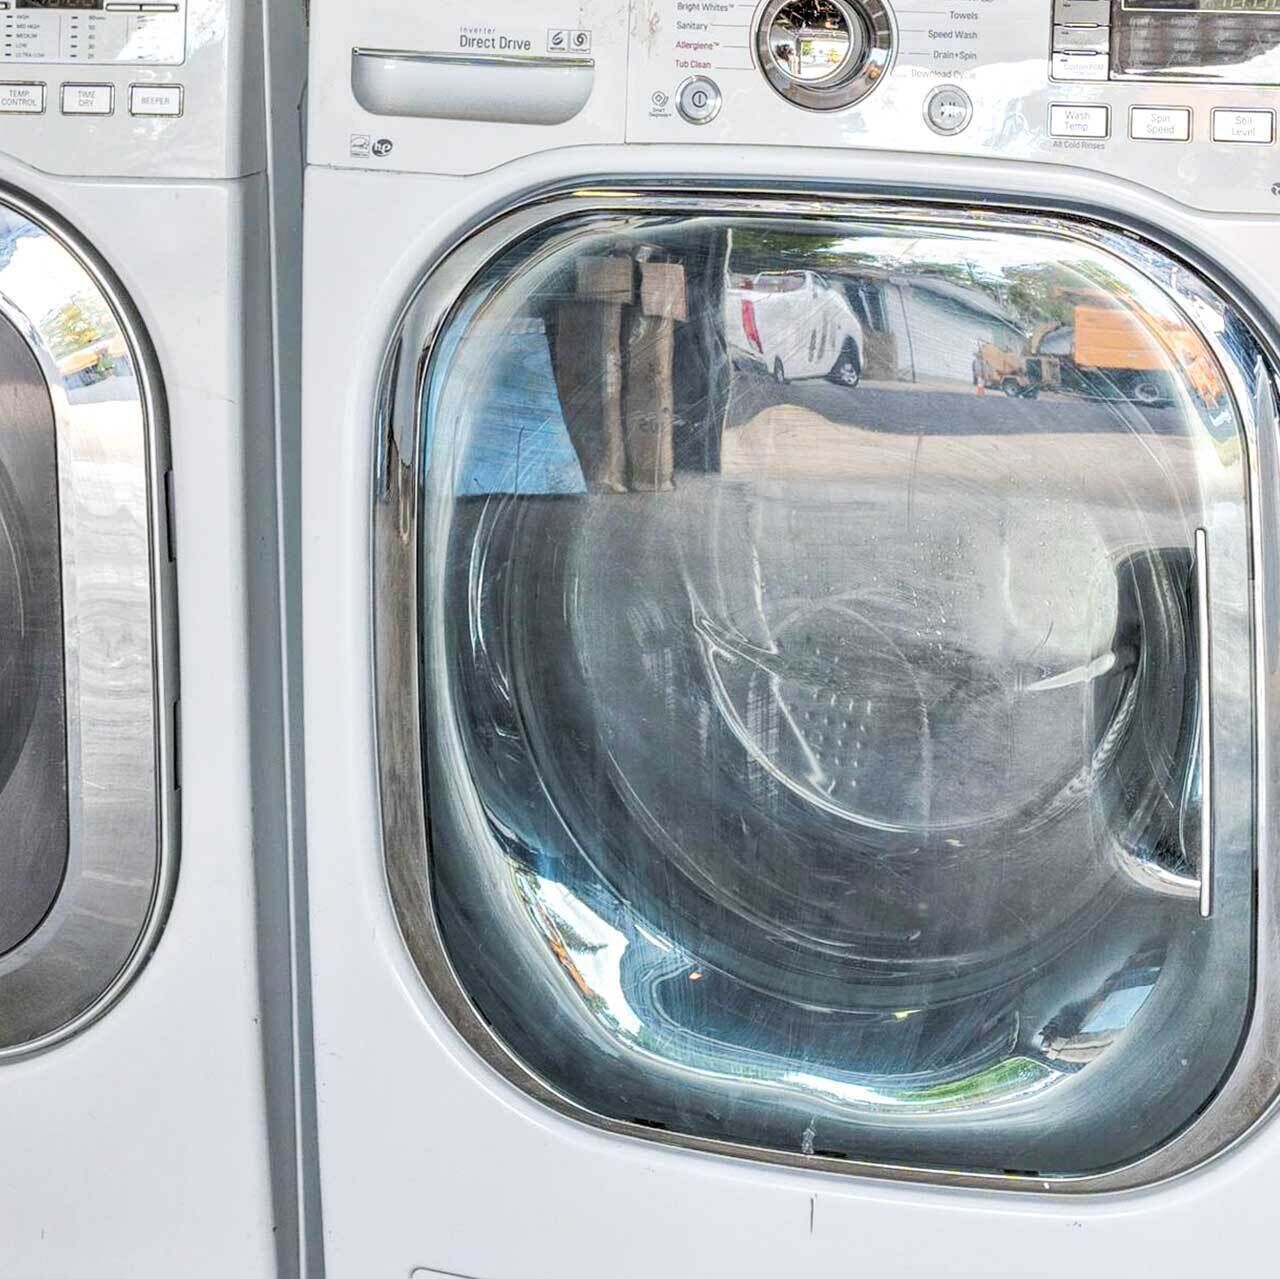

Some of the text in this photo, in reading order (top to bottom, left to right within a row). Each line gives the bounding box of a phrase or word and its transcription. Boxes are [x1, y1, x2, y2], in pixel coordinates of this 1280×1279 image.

[677, 2, 700, 13] Bright
[950, 10, 978, 20] Towels
[460, 25, 496, 34] Inverter
[676, 20, 708, 31] Sanitary
[928, 29, 978, 40] Speed Wash
[459, 34, 531, 51] Direct Drive
[675, 59, 712, 69] Tub Clean
[78, 89, 96, 98] TIME
[2, 97, 37, 107] CONTROL
[78, 98, 94, 107] DRY
[141, 96, 170, 106] BEEPER
[1064, 111, 1090, 121] Wash
[1151, 113, 1171, 124] Spin
[1235, 115, 1253, 125] Soil
[1064, 122, 1089, 133] Temp
[1146, 124, 1175, 135] Speed
[1232, 126, 1256, 137] Level
[1064, 141, 1080, 150] Cold
